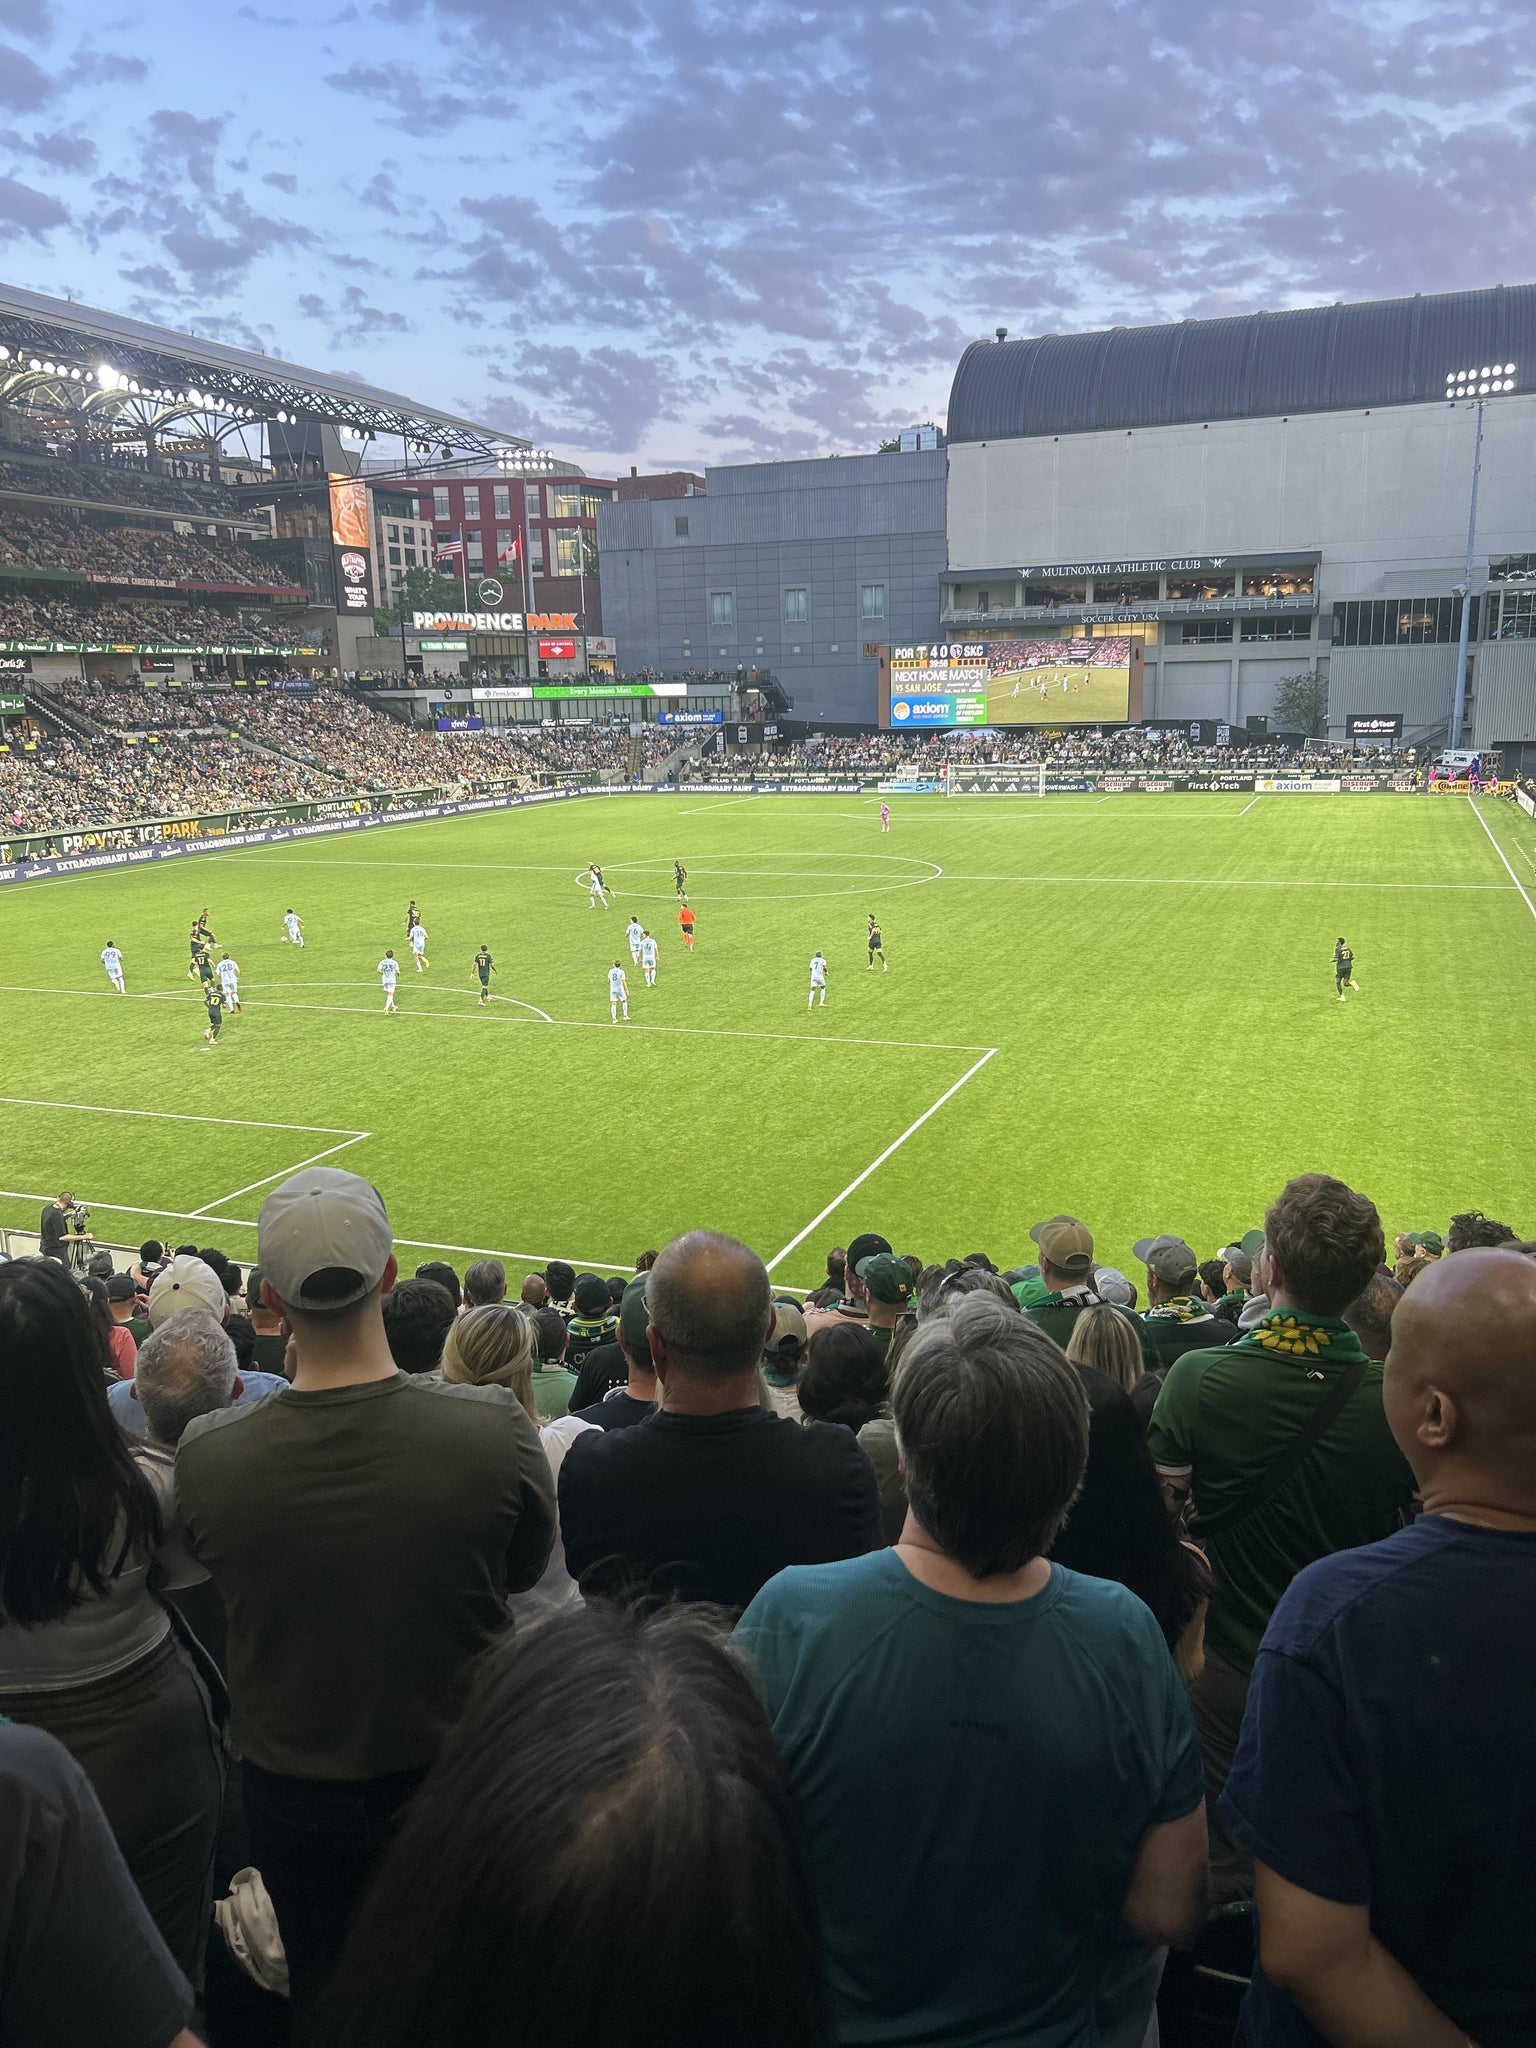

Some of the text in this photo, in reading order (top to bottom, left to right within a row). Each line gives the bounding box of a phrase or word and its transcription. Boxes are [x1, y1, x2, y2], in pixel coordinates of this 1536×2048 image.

[1042, 559, 1201, 577] MULTNOMAH ATHLETIC CLUB
[413, 612, 579, 631] PROVIDENCE PARK
[1081, 615, 1114, 624] SOCCER
[1118, 614, 1138, 622] CITY
[895, 645, 984, 659] POR 4 0 SKC
[896, 669, 983, 682] NEXT HOME MATCH
[570, 687, 587, 695] Every
[905, 684, 920, 692] SAN
[922, 683, 942, 692] JOSE
[492, 690, 520, 698] Providence
[912, 702, 949, 714] axiom
[674, 714, 702, 722] axiom
[451, 720, 468, 729] xfinity
[632, 784, 653, 792] DAIRY
[1188, 782, 1208, 790] First
[1276, 781, 1312, 790] axiom
[382, 808, 440, 822] EXTRAORDINARY DAIRY
[292, 819, 360, 836] EXTRAORDINARY DAIRY
[185, 832, 266, 852] EXTRAORDINARY DAIRY
[56, 849, 153, 872] EXTRAORDINARY DAIRY
[633, 928, 638, 936] 6
[104, 951, 116, 959] 99
[222, 964, 232, 972] 28
[383, 964, 393, 972] 23
[814, 962, 819, 970] 7
[210, 996, 219, 1004] 10
